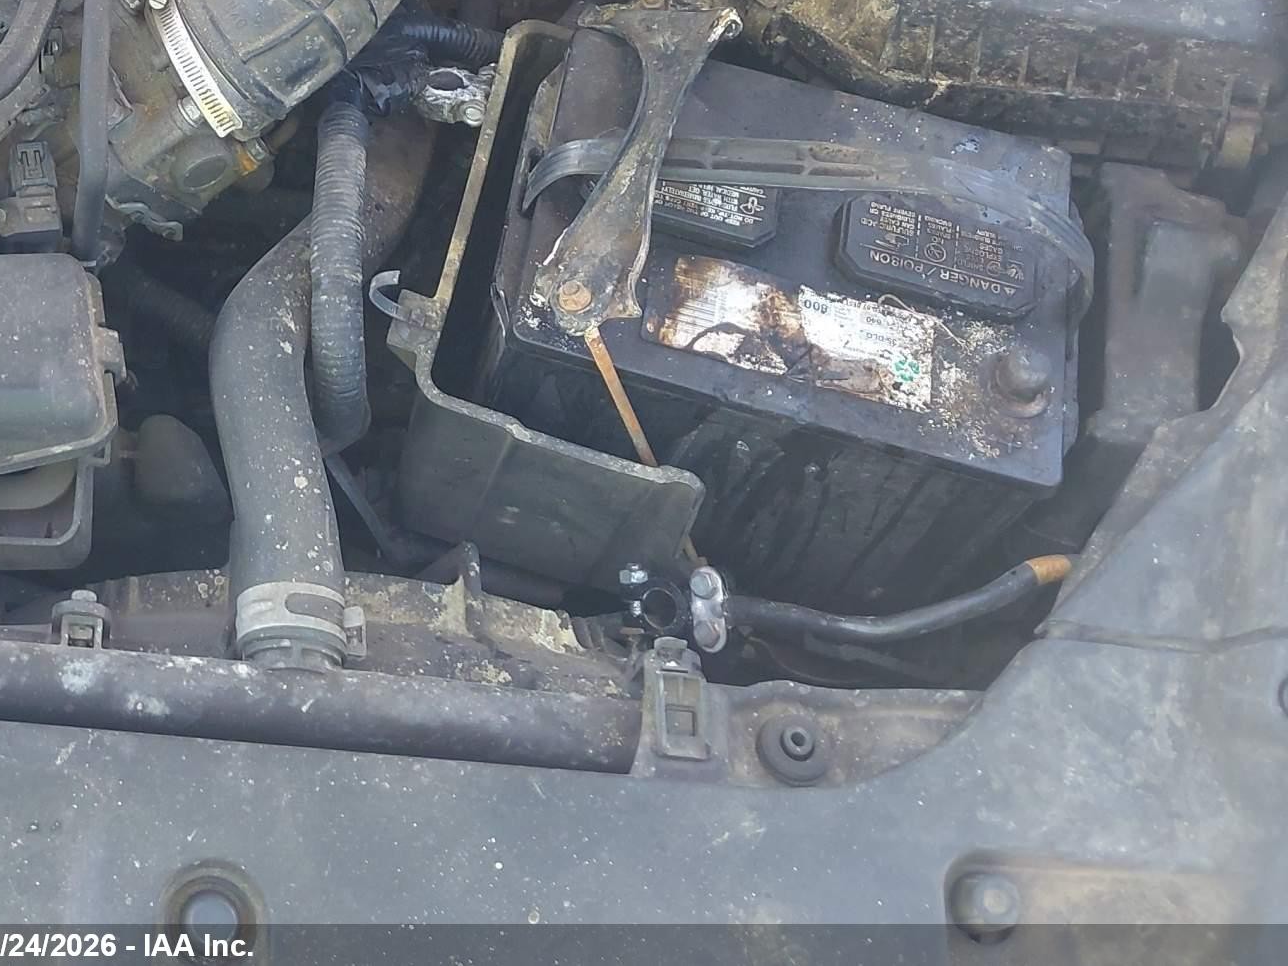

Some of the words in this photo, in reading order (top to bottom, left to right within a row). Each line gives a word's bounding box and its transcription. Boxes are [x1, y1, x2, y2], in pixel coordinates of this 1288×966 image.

[931, 236, 944, 245] NO
[869, 249, 924, 273] POISON
[939, 270, 1001, 294] DANGER
[803, 299, 829, 314] 800
